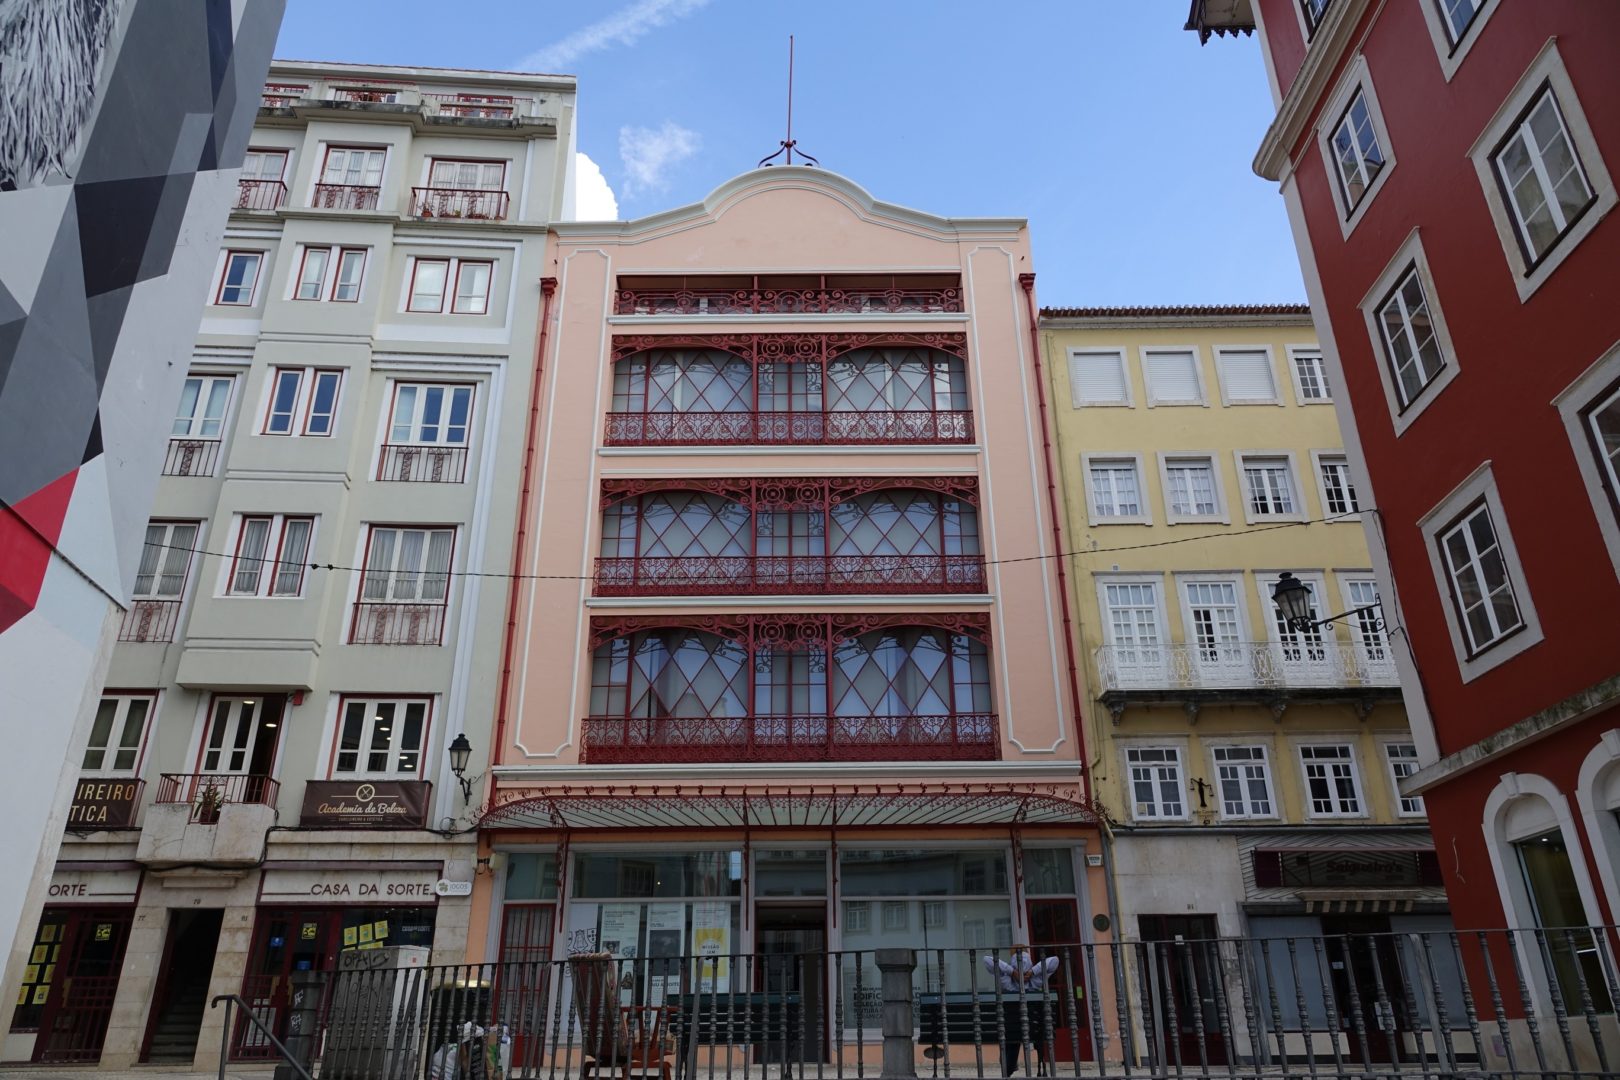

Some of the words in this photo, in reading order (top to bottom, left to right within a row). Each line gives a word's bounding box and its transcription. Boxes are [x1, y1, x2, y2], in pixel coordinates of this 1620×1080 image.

[318, 802, 364, 814] Academia
[365, 802, 376, 814] de
[377, 802, 407, 815] Beleza
[310, 883, 351, 895] CASA
[358, 883, 379, 895] DA
[386, 883, 430, 895] SORTE
